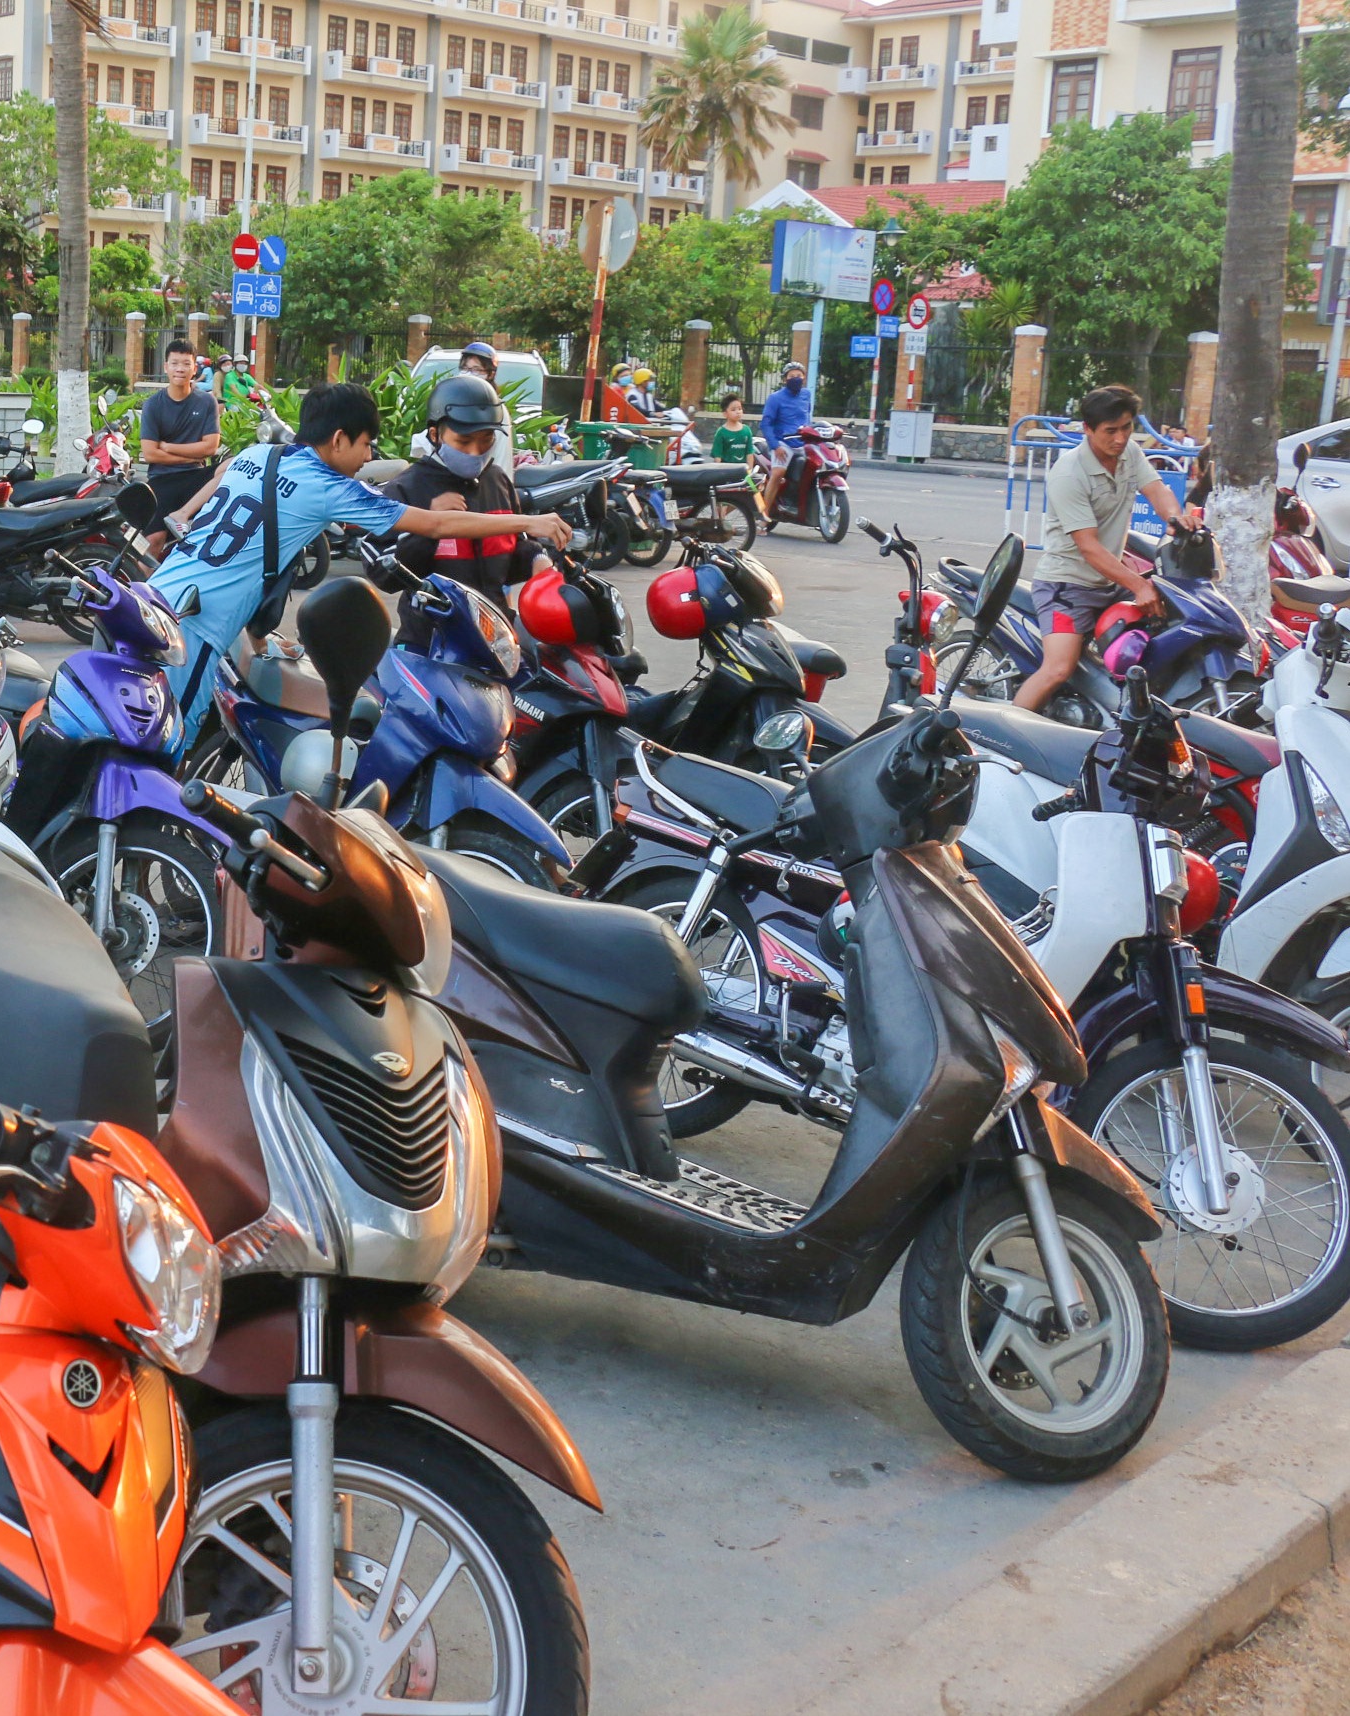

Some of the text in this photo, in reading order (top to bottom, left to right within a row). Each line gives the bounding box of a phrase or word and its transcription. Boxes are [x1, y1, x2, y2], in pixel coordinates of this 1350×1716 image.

[174, 484, 265, 568] 28
[513, 695, 545, 722] YAMAHA
[772, 859, 817, 877] HONDA
